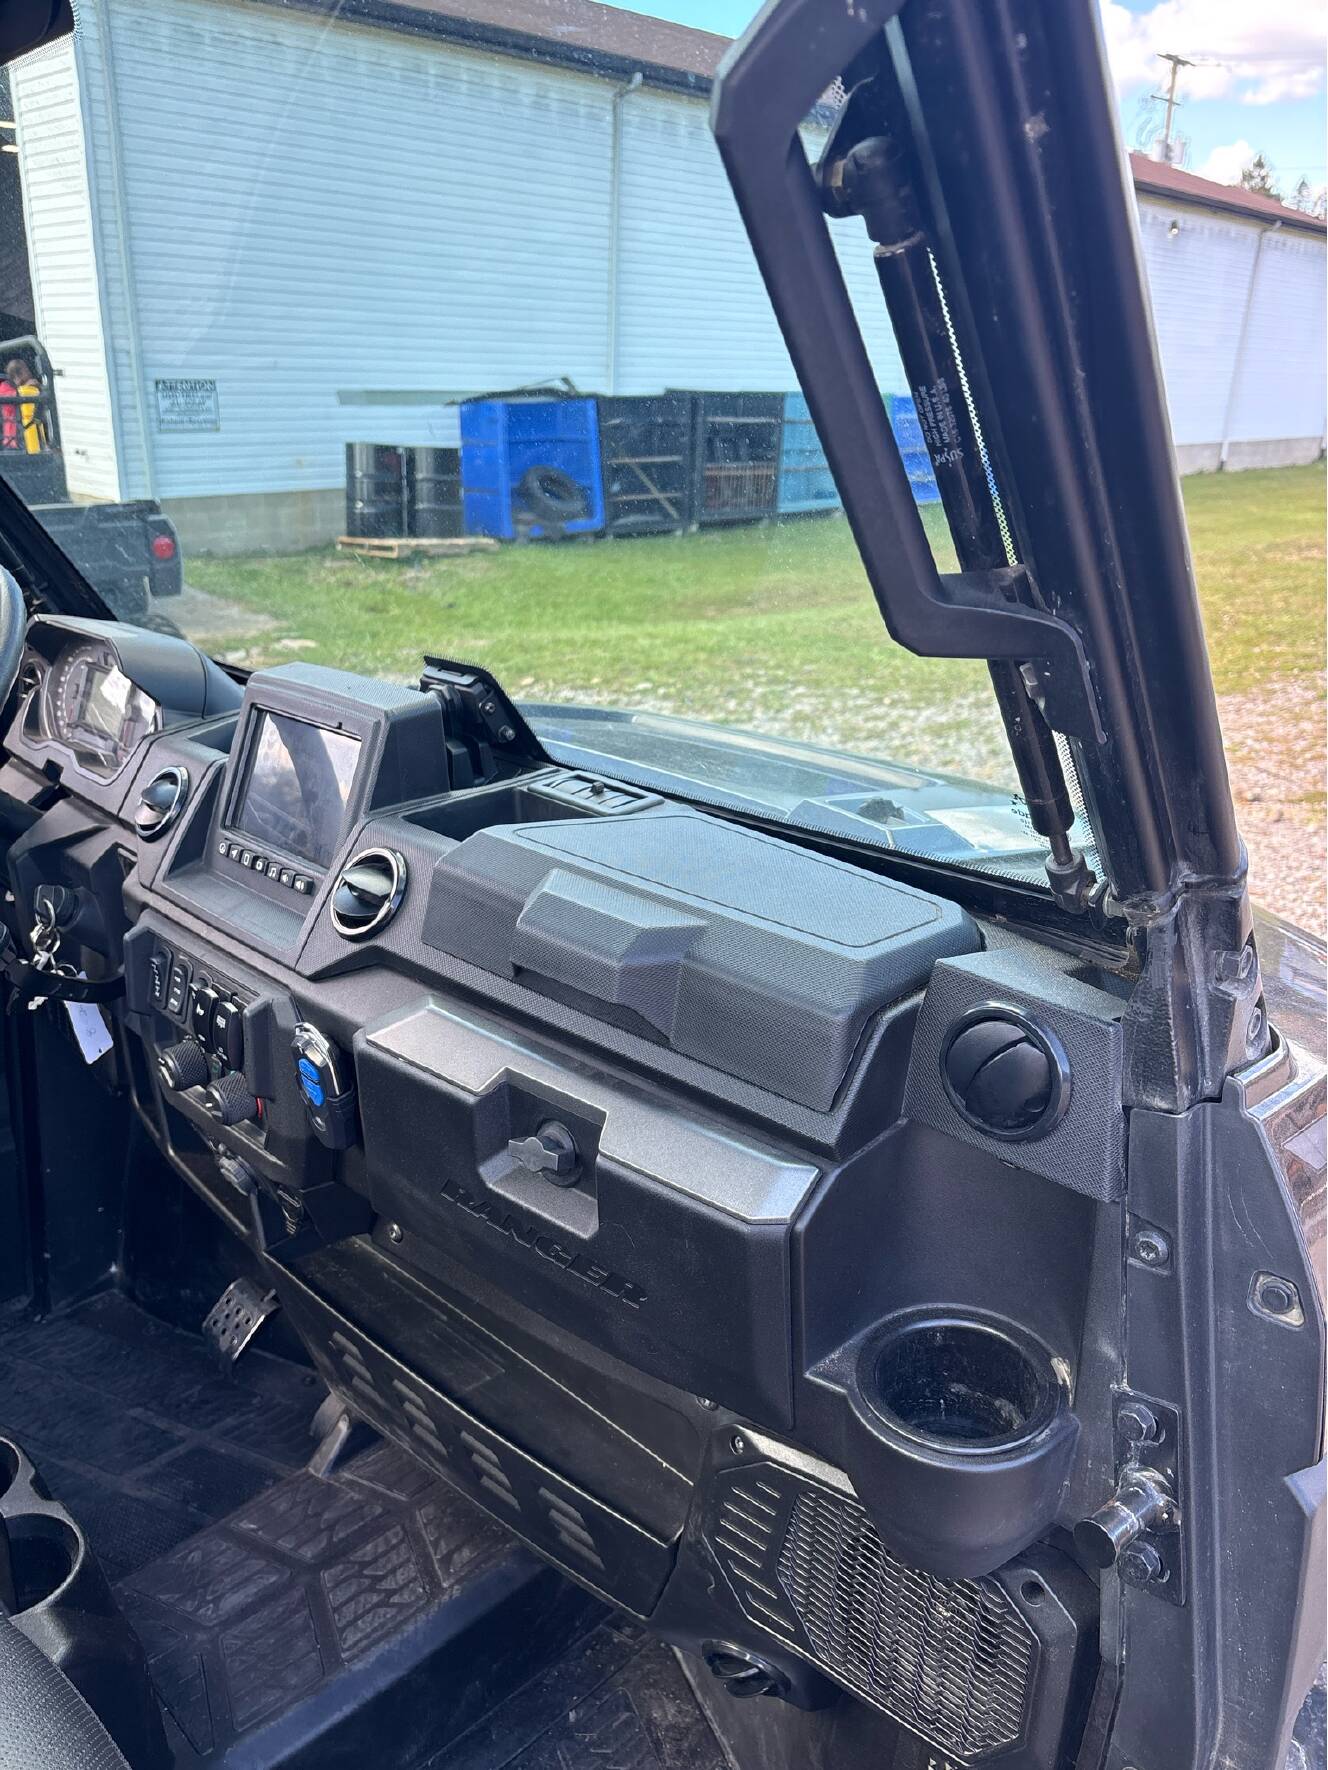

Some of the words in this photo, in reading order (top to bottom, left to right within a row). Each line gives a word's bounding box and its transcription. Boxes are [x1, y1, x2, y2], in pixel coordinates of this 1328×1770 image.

[157, 379, 216, 391] ATTENTION
[919, 385, 938, 427] PRESSURE
[931, 427, 942, 447] HIGH
[940, 421, 950, 443] MADE
[440, 1178, 649, 1309] RANGER
